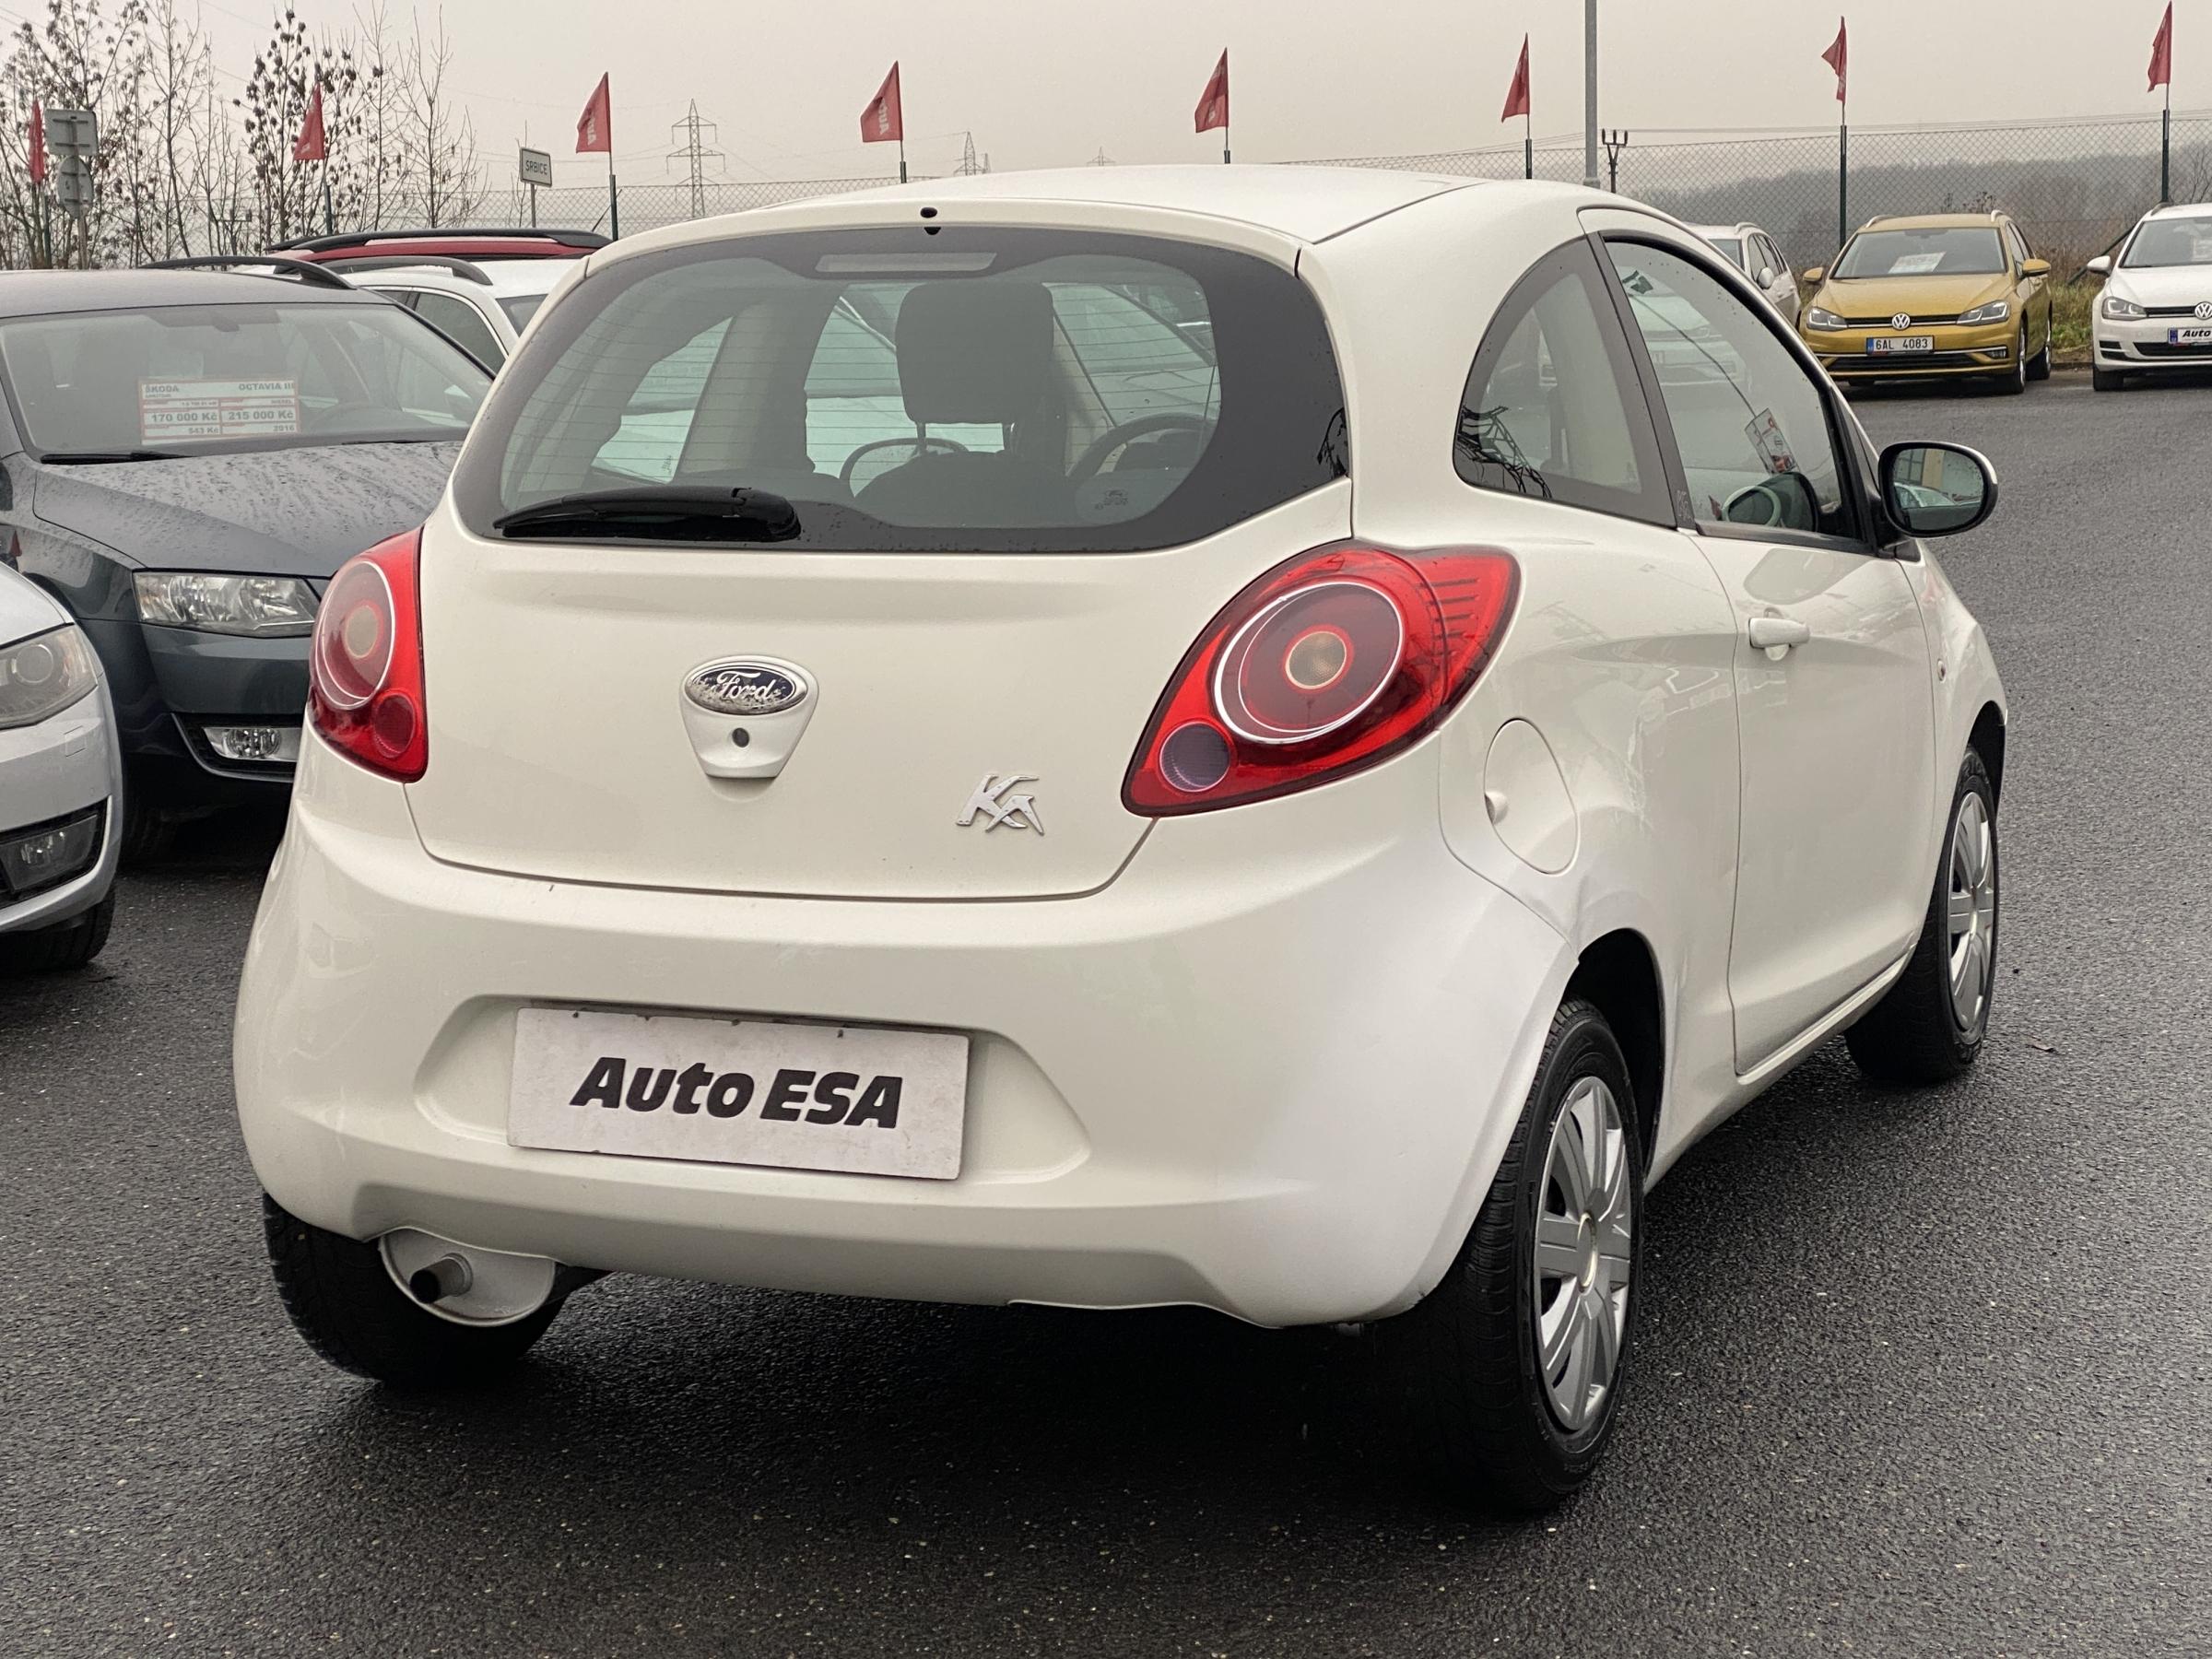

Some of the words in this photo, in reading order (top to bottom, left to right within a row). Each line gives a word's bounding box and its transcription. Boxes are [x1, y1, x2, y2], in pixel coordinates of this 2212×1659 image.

[525, 159, 547, 175] SRBICE
[1876, 340, 1895, 350] 6AL
[1902, 338, 1928, 349] 4083
[151, 414, 173, 423] 170
[176, 413, 198, 422] 000
[202, 412, 218, 421] Kč
[228, 411, 250, 421] 215
[253, 411, 275, 420] 000
[277, 409, 294, 419] Kč
[716, 670, 777, 700] Ford
[569, 1056, 755, 1119] Auto
[759, 1069, 903, 1129] ESA
